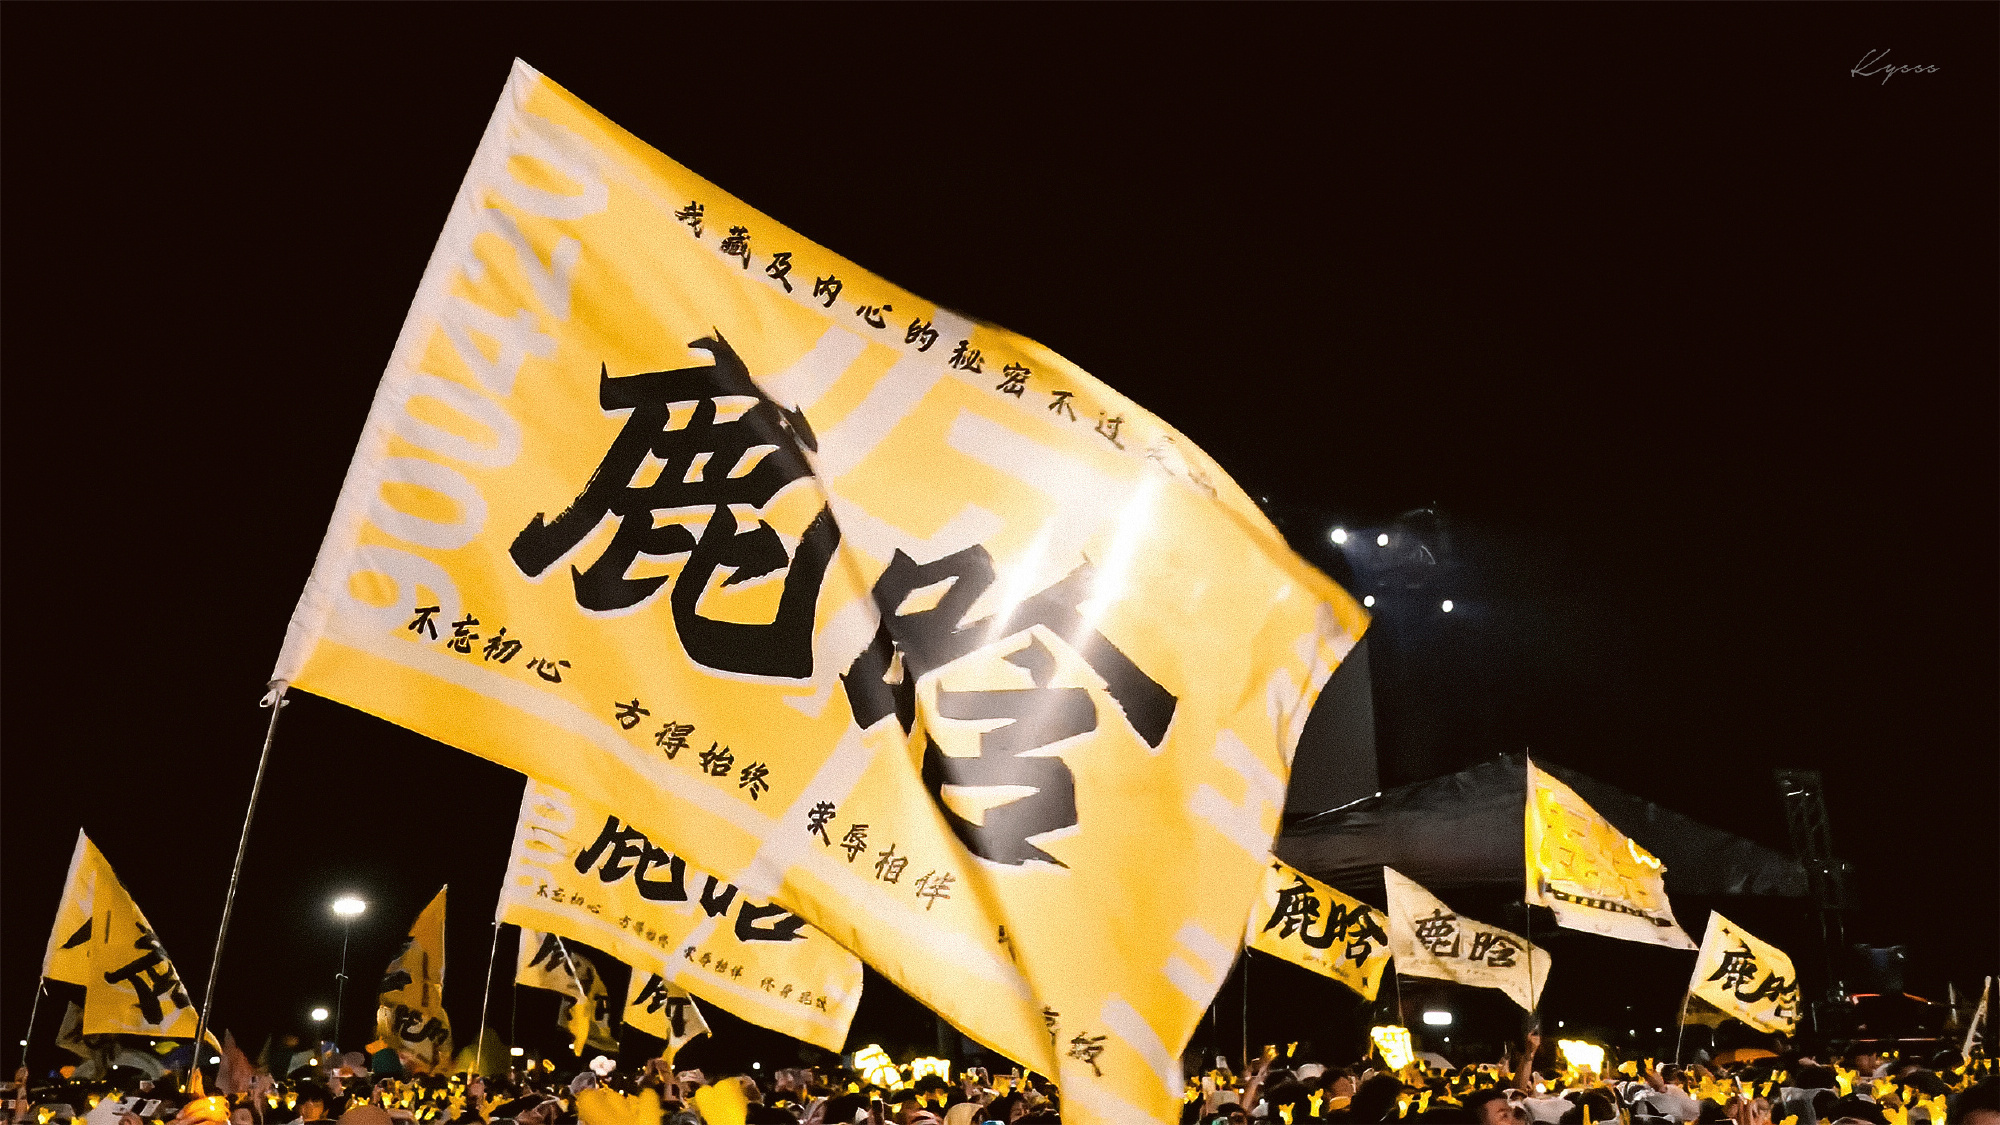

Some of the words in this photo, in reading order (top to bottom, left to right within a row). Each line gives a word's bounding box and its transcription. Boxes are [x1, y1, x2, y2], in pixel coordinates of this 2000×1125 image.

[675, 200, 1218, 498] 我藏及内心的秘密不过
[508, 326, 1179, 868] 鹿晗
[408, 606, 571, 684] 不忘初心
[615, 698, 770, 801] 方得始终
[807, 800, 956, 911] 荣辱相伴
[1262, 874, 1390, 968] 鹿晗
[1415, 908, 1526, 969] 鹿晗
